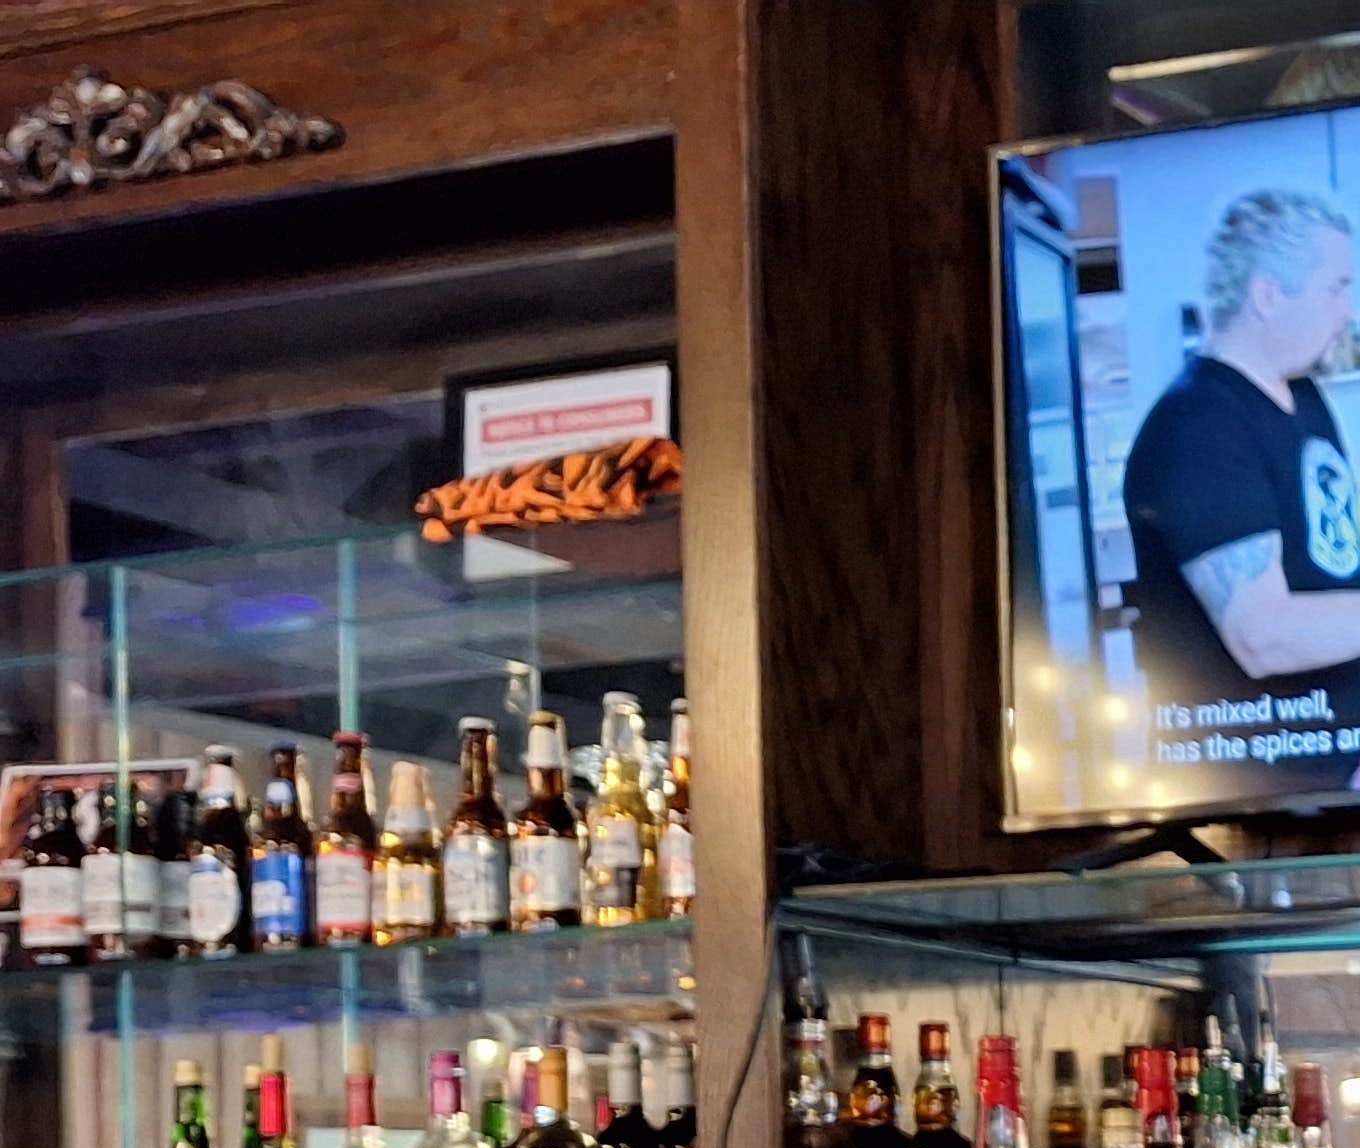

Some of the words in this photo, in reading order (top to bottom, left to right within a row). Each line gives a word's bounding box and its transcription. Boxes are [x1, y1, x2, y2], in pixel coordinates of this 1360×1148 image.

[1155, 704, 1192, 730] It's
[1197, 694, 1271, 725] mixed
[1276, 689, 1334, 722] well,
[1156, 738, 1201, 763] has
[1205, 732, 1246, 761] the
[1249, 727, 1332, 766] spices
